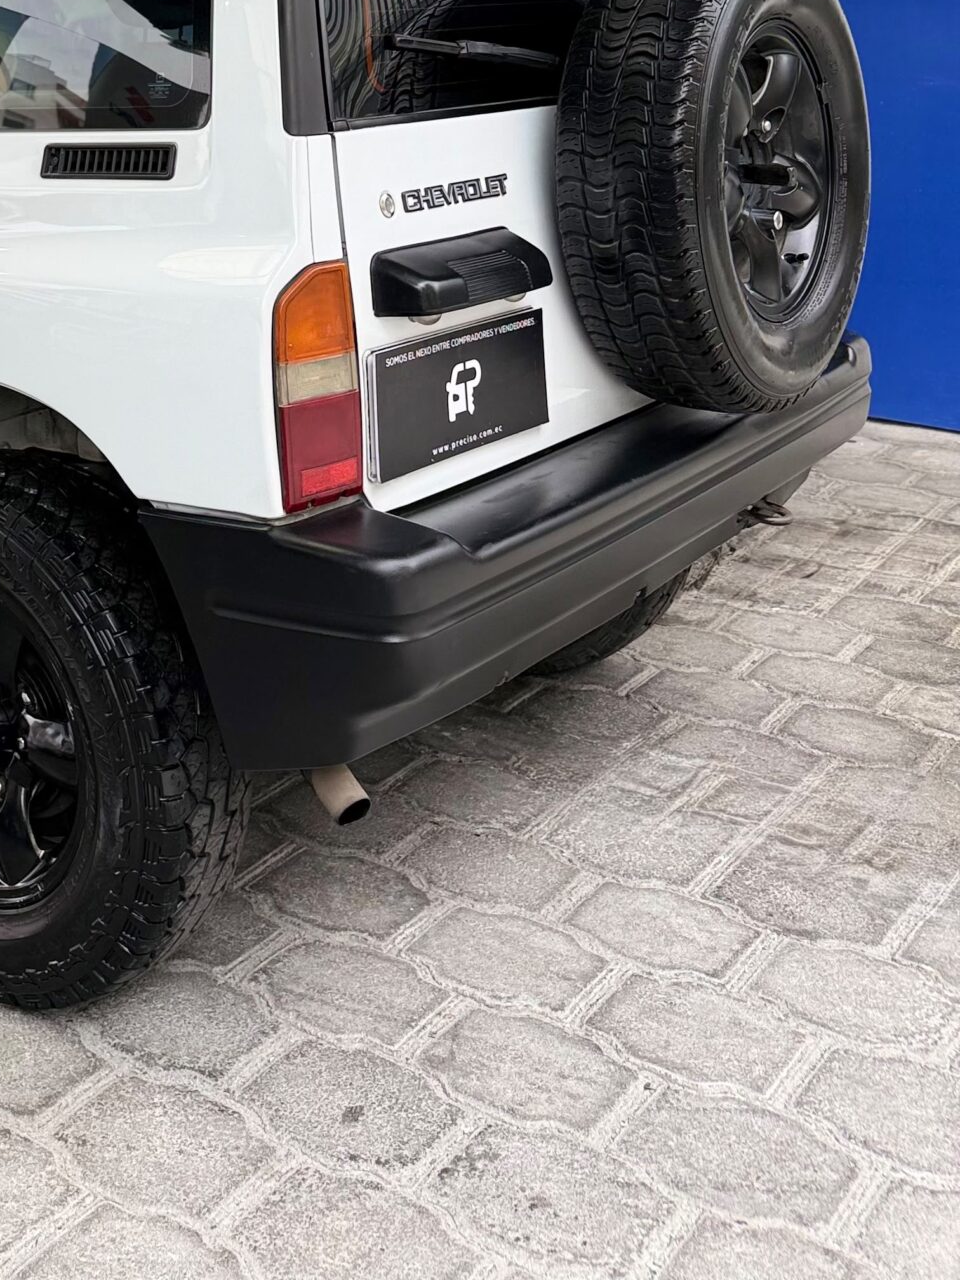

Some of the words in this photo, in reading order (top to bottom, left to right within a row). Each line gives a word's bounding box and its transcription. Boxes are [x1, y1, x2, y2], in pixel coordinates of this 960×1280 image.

[401, 173, 508, 213] CHEVROLET
[385, 352, 408, 368] SOMOS
[407, 351, 416, 361] EL
[415, 346, 432, 358] NEXO
[432, 340, 451, 353] ENTRE
[450, 328, 494, 348] COMPRADORES
[431, 424, 503, 456] www.preciso.com.ec
